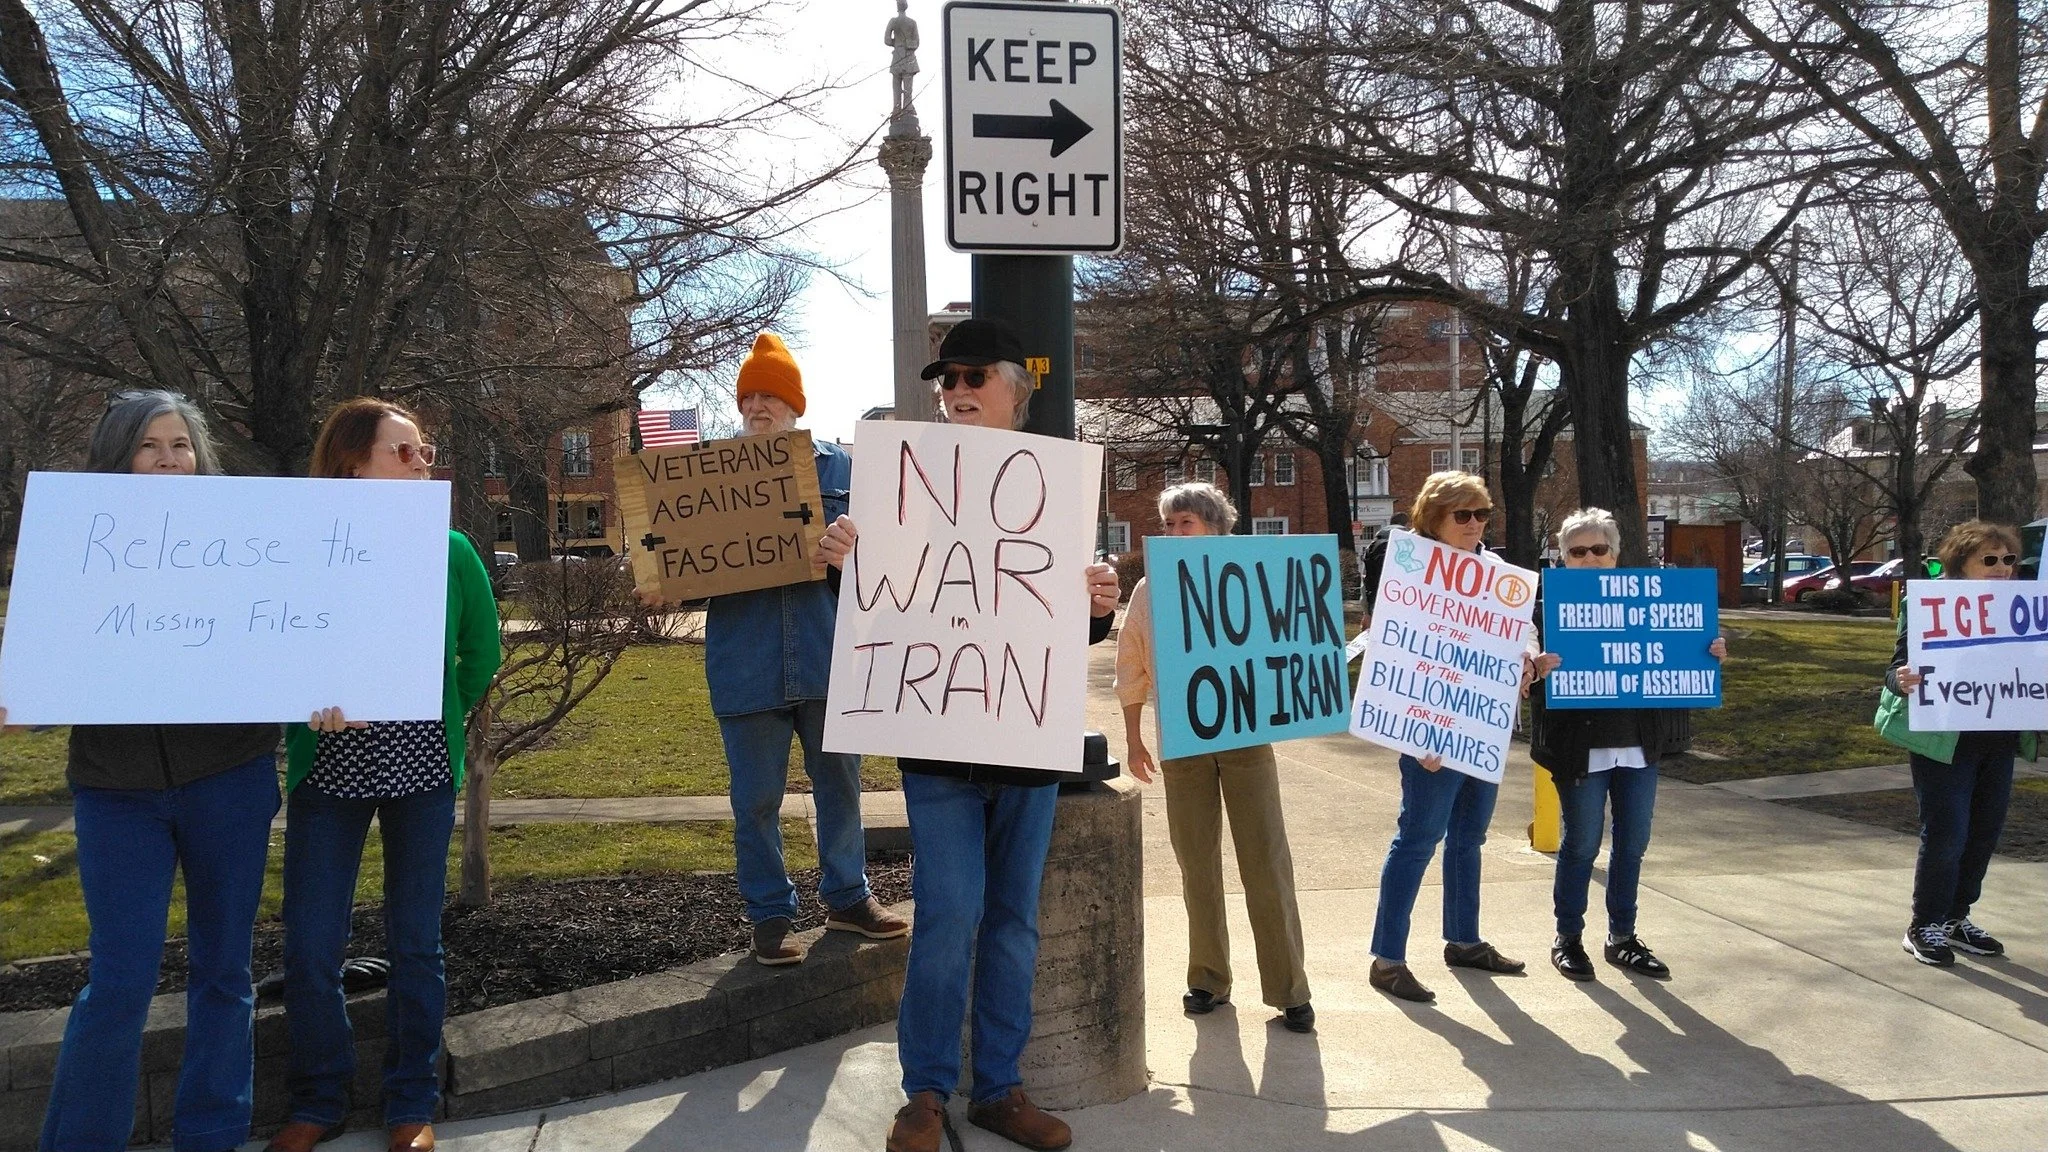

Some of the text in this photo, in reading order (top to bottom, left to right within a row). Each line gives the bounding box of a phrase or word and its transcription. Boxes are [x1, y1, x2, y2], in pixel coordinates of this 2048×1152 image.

[967, 37, 1097, 84] KEEP
[959, 170, 1109, 216] RIGHT
[640, 436, 790, 484] VETERANS
[899, 440, 1046, 534] NO
[82, 511, 371, 575] Release the
[853, 535, 1055, 620] WAR
[1424, 546, 1495, 600] NO!
[1599, 575, 1662, 597] THIS IS
[95, 599, 330, 647] Missing Files
[951, 615, 969, 630] in
[1178, 553, 1342, 654] NO WAR
[1384, 579, 1529, 642] GOVERNMENT
[1558, 603, 1704, 629] FREEDOM OF SPEECH
[1920, 593, 1996, 639] ICE
[1428, 622, 1473, 644] OF THE
[1600, 642, 1664, 665] THIS IS
[841, 641, 1051, 728] IRAN
[1187, 650, 1343, 741] ON IRAN
[1415, 660, 1464, 684] BY THE
[1551, 669, 1716, 696] FREEDOM OF ASSEMBLY
[1406, 704, 1457, 729] FOR THE
